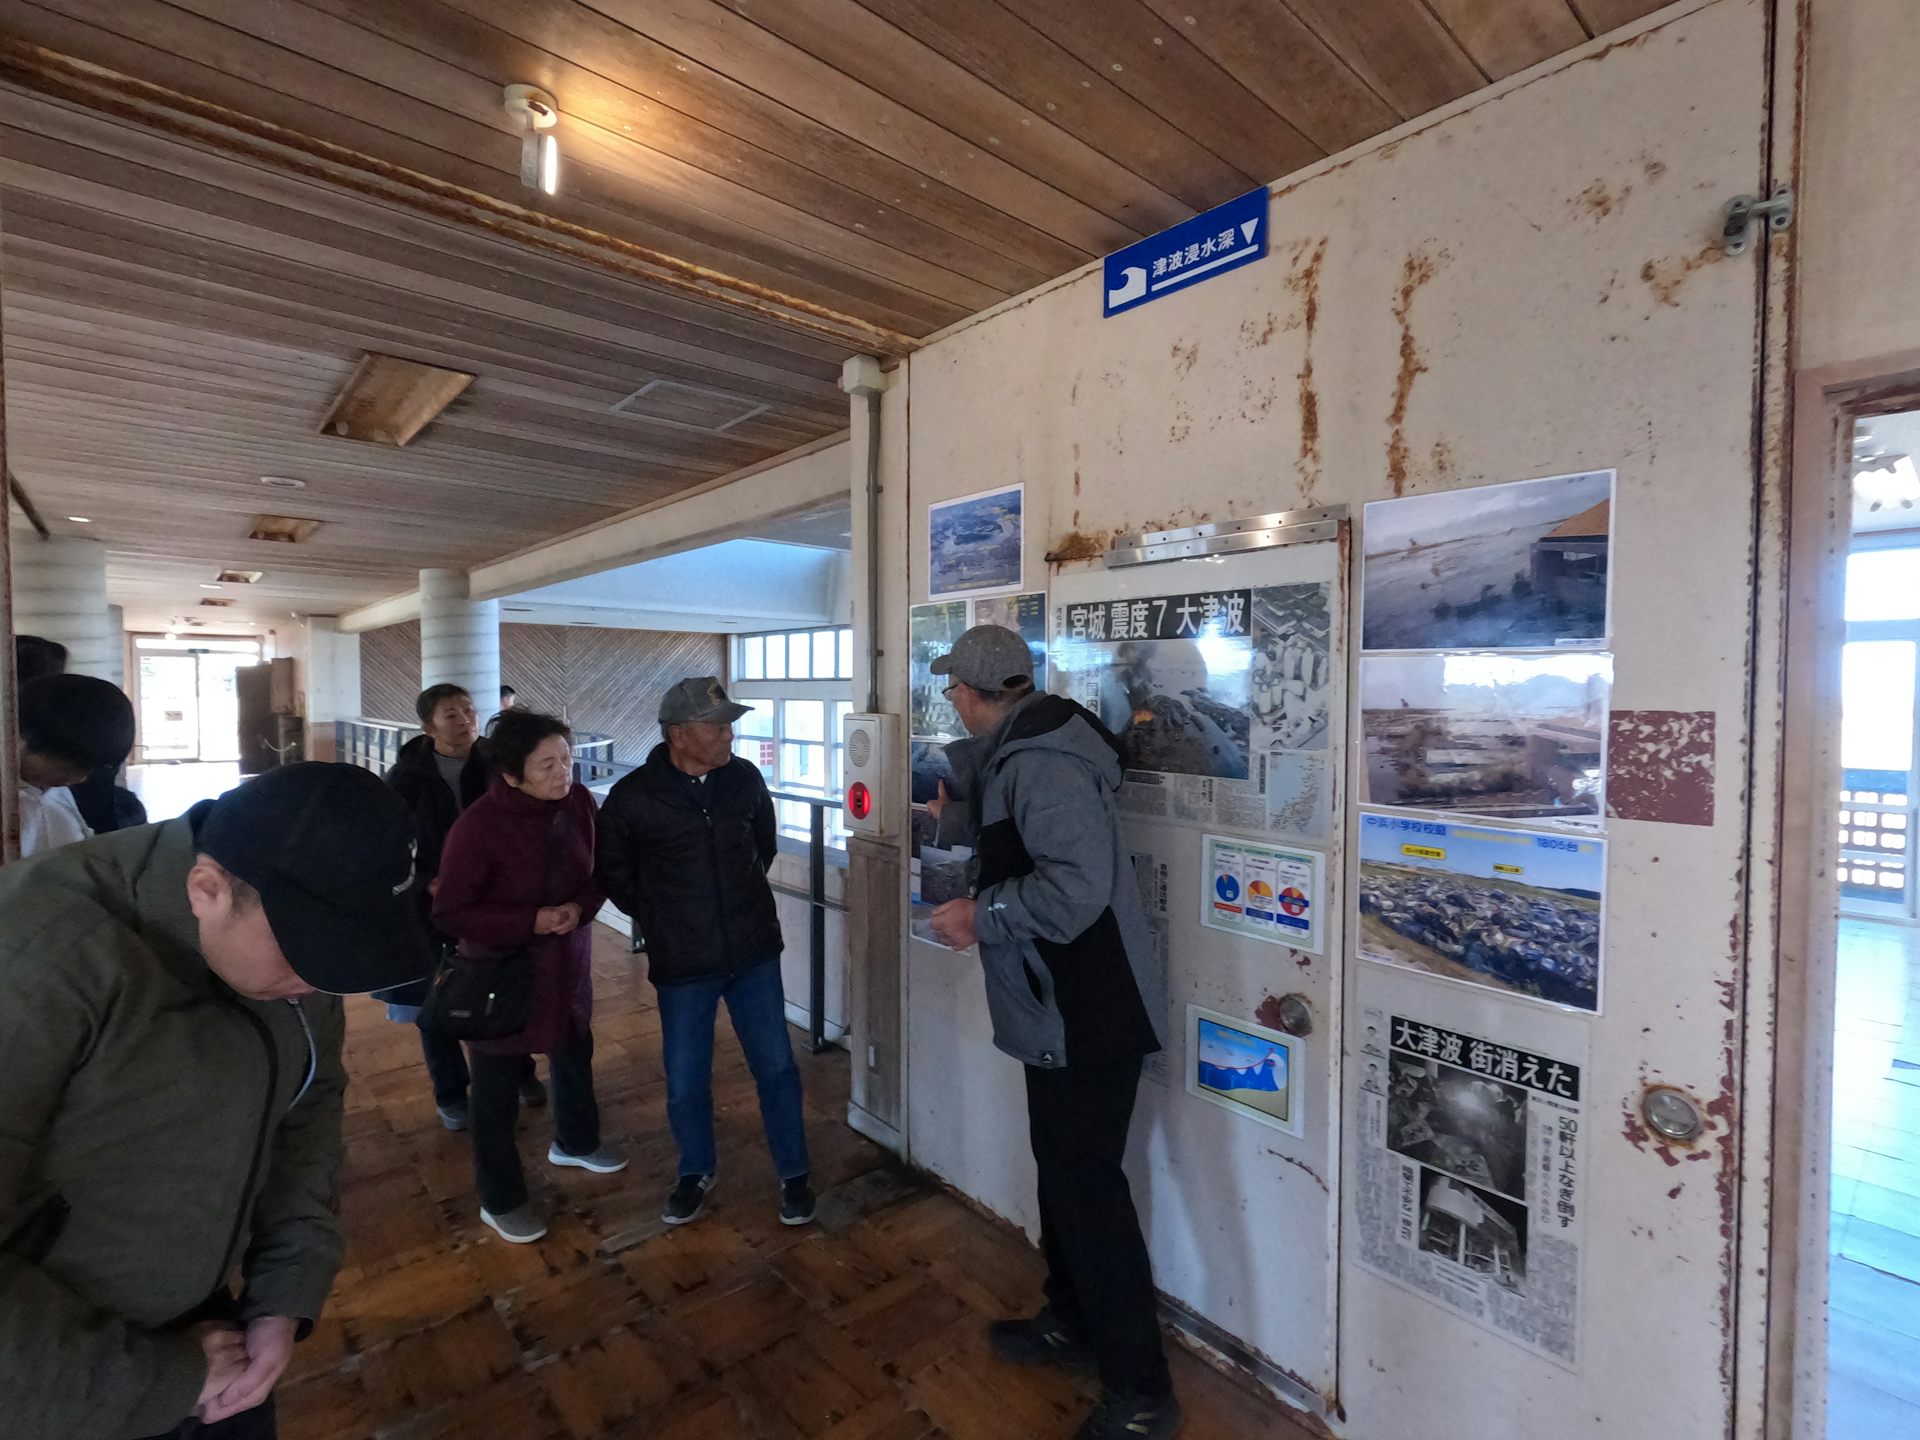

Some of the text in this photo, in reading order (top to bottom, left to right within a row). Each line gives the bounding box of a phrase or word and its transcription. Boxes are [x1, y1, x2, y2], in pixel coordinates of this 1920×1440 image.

[1152, 228, 1235, 277] 津波浸水深
[1070, 604, 1107, 641] 宮城
[1175, 592, 1246, 637] 大津波
[1395, 1021, 1573, 1097] 大津波 街消えた
